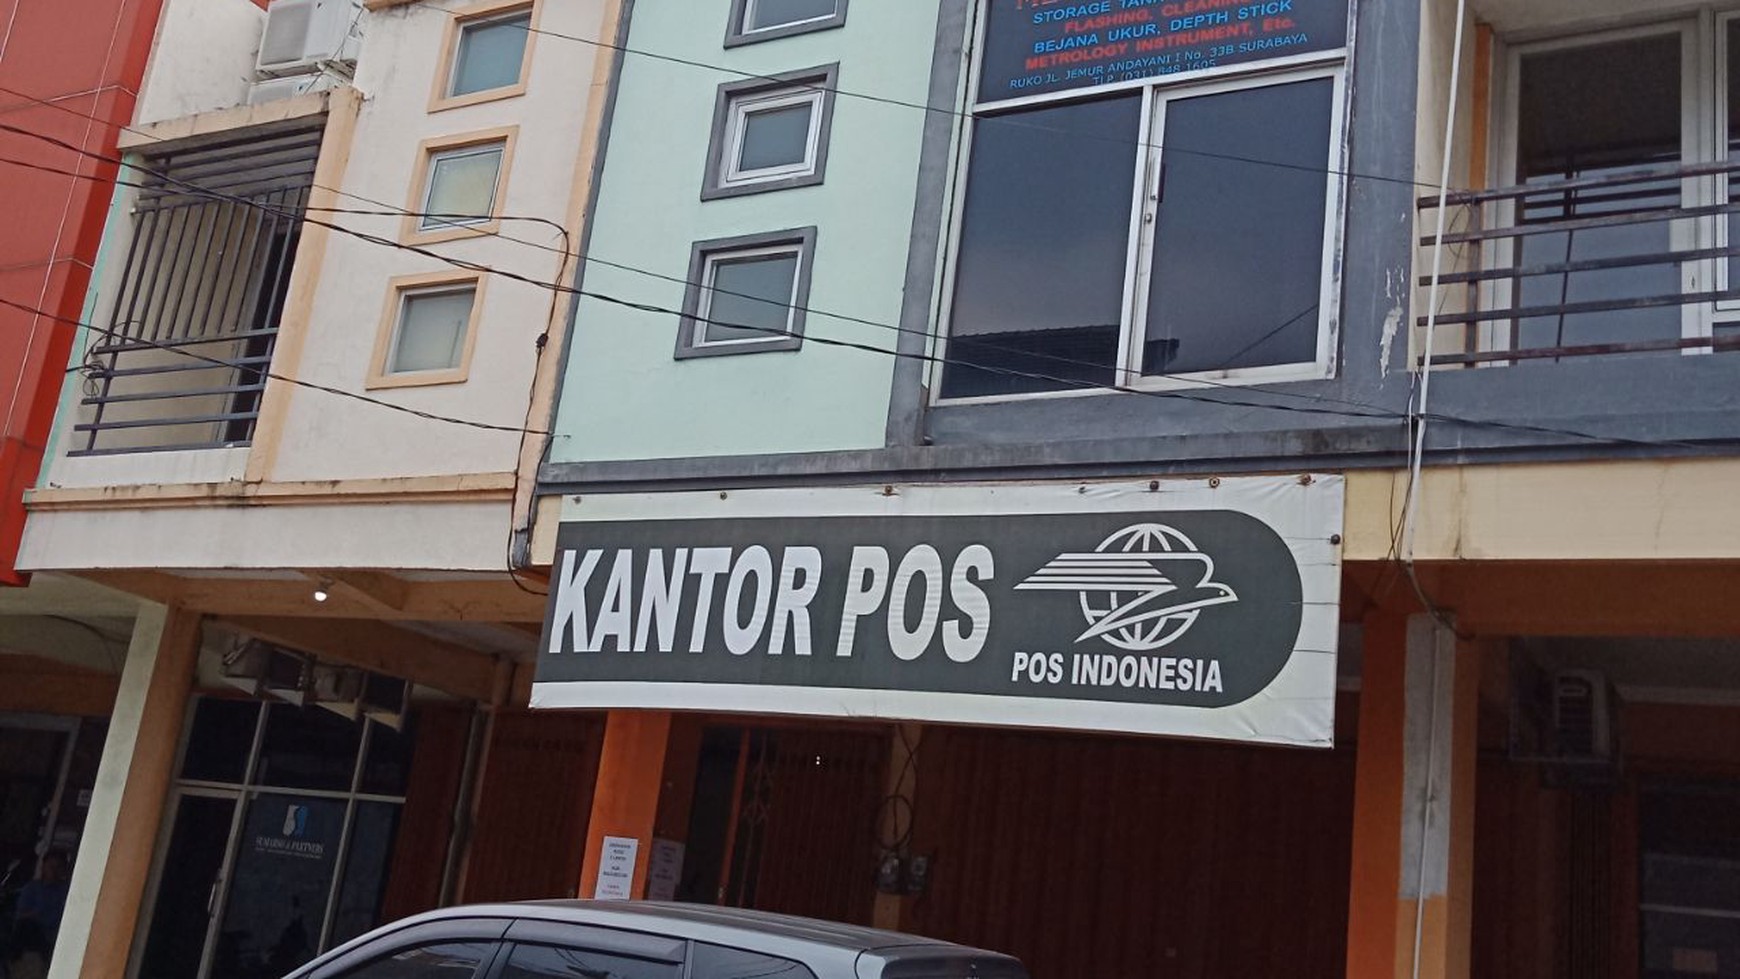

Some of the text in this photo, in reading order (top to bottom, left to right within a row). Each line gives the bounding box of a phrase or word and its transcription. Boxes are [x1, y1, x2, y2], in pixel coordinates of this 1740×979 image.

[1033, 2, 1111, 23] STORAGE
[1034, 33, 1098, 53] BEJANA
[1170, 11, 1229, 31] DEPTH
[1238, 0, 1292, 19] STICK
[1009, 75, 1042, 88] RUKO
[1065, 66, 1104, 80] JEMUR
[1107, 54, 1170, 72] ANDAYANI
[1184, 50, 1205, 60] No.
[1209, 44, 1234, 57] 33B
[1239, 33, 1308, 53] SURABAYA
[1025, 43, 1128, 70] METROLOGY
[1262, 17, 1296, 32] Etc.
[548, 544, 995, 663] KANTOR POS
[1011, 652, 1223, 693] POS INDONESIA
